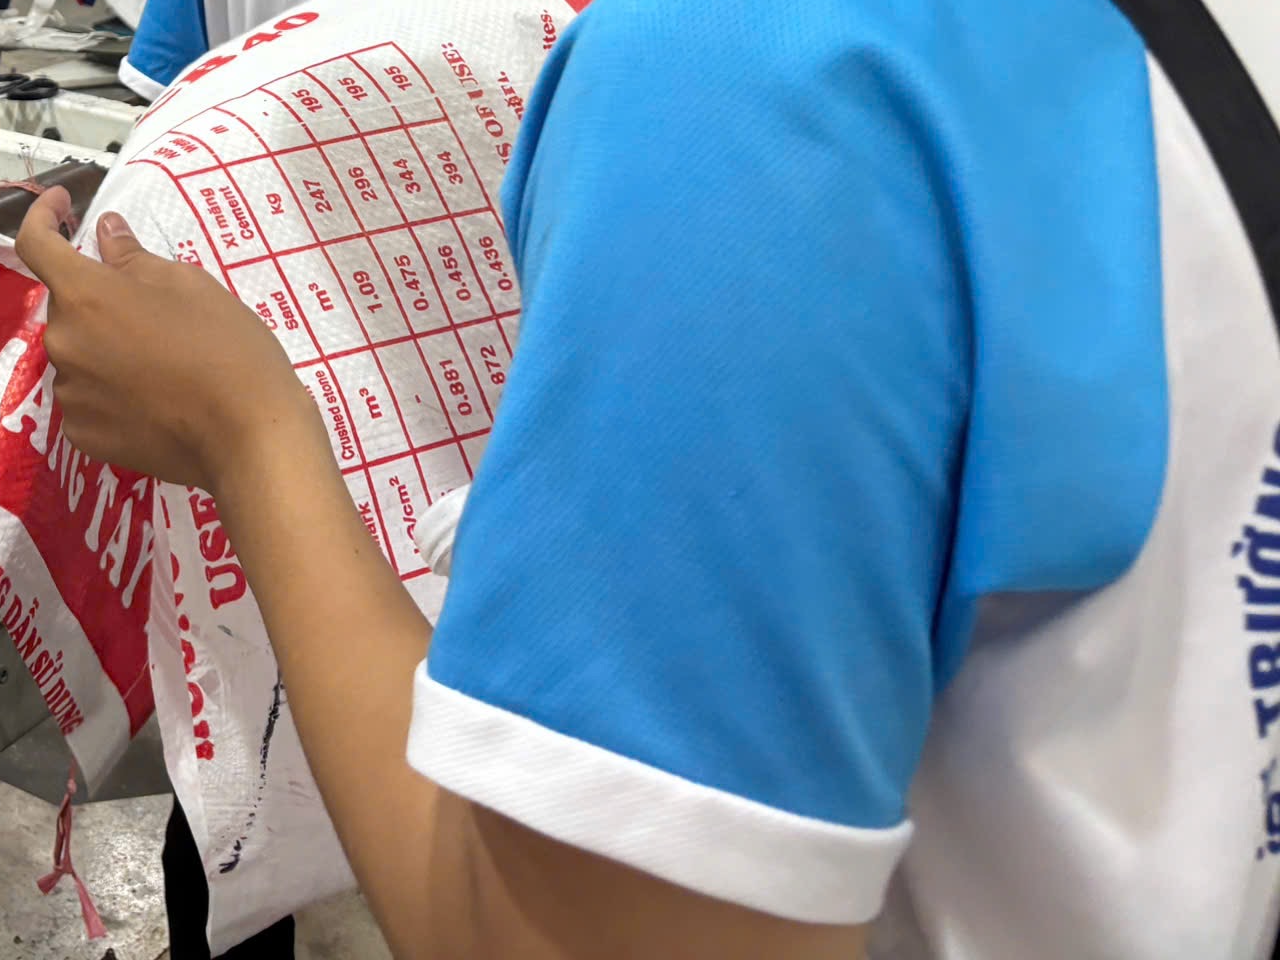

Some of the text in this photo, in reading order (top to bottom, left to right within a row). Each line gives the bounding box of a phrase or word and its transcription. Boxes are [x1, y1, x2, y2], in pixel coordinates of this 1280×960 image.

[337, 77, 368, 101] 195
[384, 66, 412, 91] 195
[291, 89, 323, 113] 195
[475, 104, 504, 138] OF
[348, 166, 379, 202] 296
[393, 158, 421, 194] 344
[437, 150, 464, 186] 394
[218, 186, 254, 240] Cement
[303, 179, 333, 214] 247
[437, 245, 471, 302] 0.456
[478, 235, 513, 291] 0.436
[353, 270, 384, 314] 1.09
[393, 254, 429, 312] 0.475
[270, 291, 299, 331] Sand
[439, 359, 472, 416] 0.881
[315, 370, 355, 460] Crushed stone
